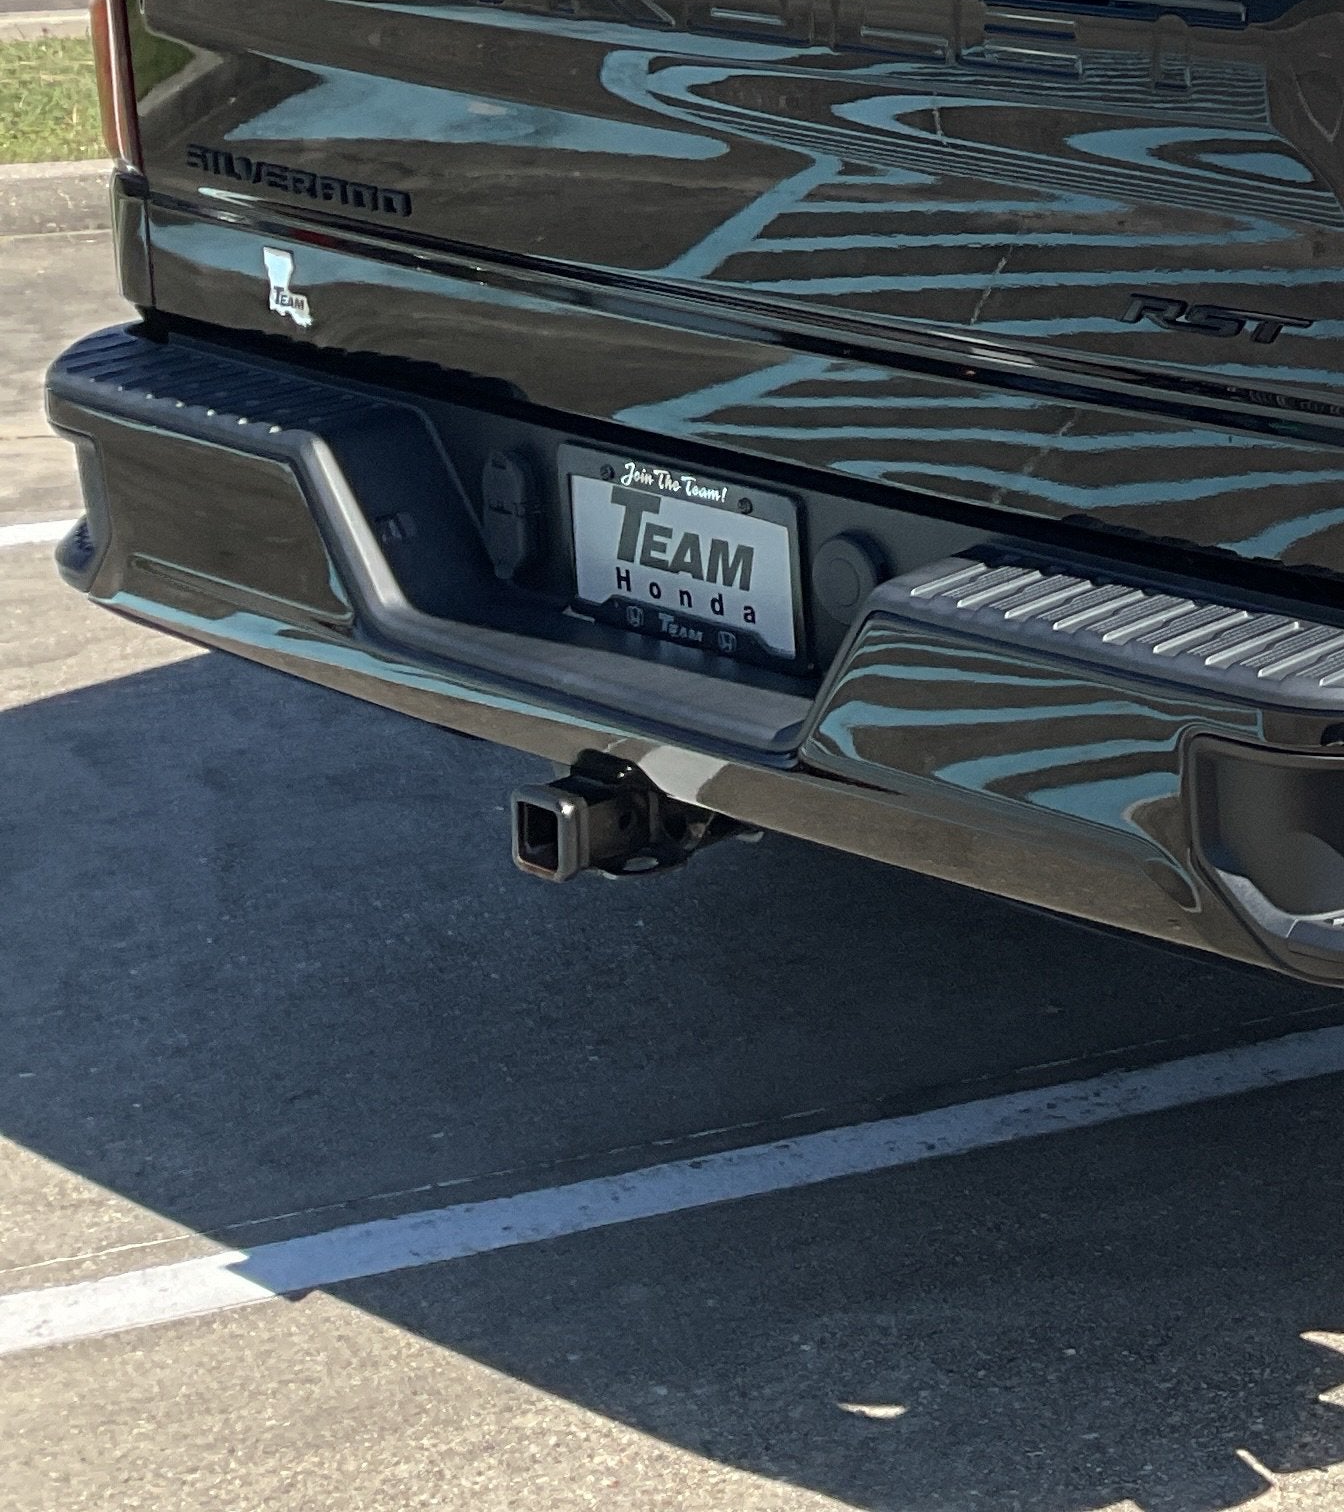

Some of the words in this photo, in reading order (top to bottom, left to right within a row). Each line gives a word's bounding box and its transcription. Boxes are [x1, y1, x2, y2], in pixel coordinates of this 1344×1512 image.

[185, 143, 413, 218] SILVERADO
[1120, 292, 1315, 345] RST
[620, 462, 655, 486] Join
[653, 469, 681, 492] The
[681, 475, 728, 503] Team!
[611, 485, 755, 592] TEAM
[615, 566, 757, 625] Honda
